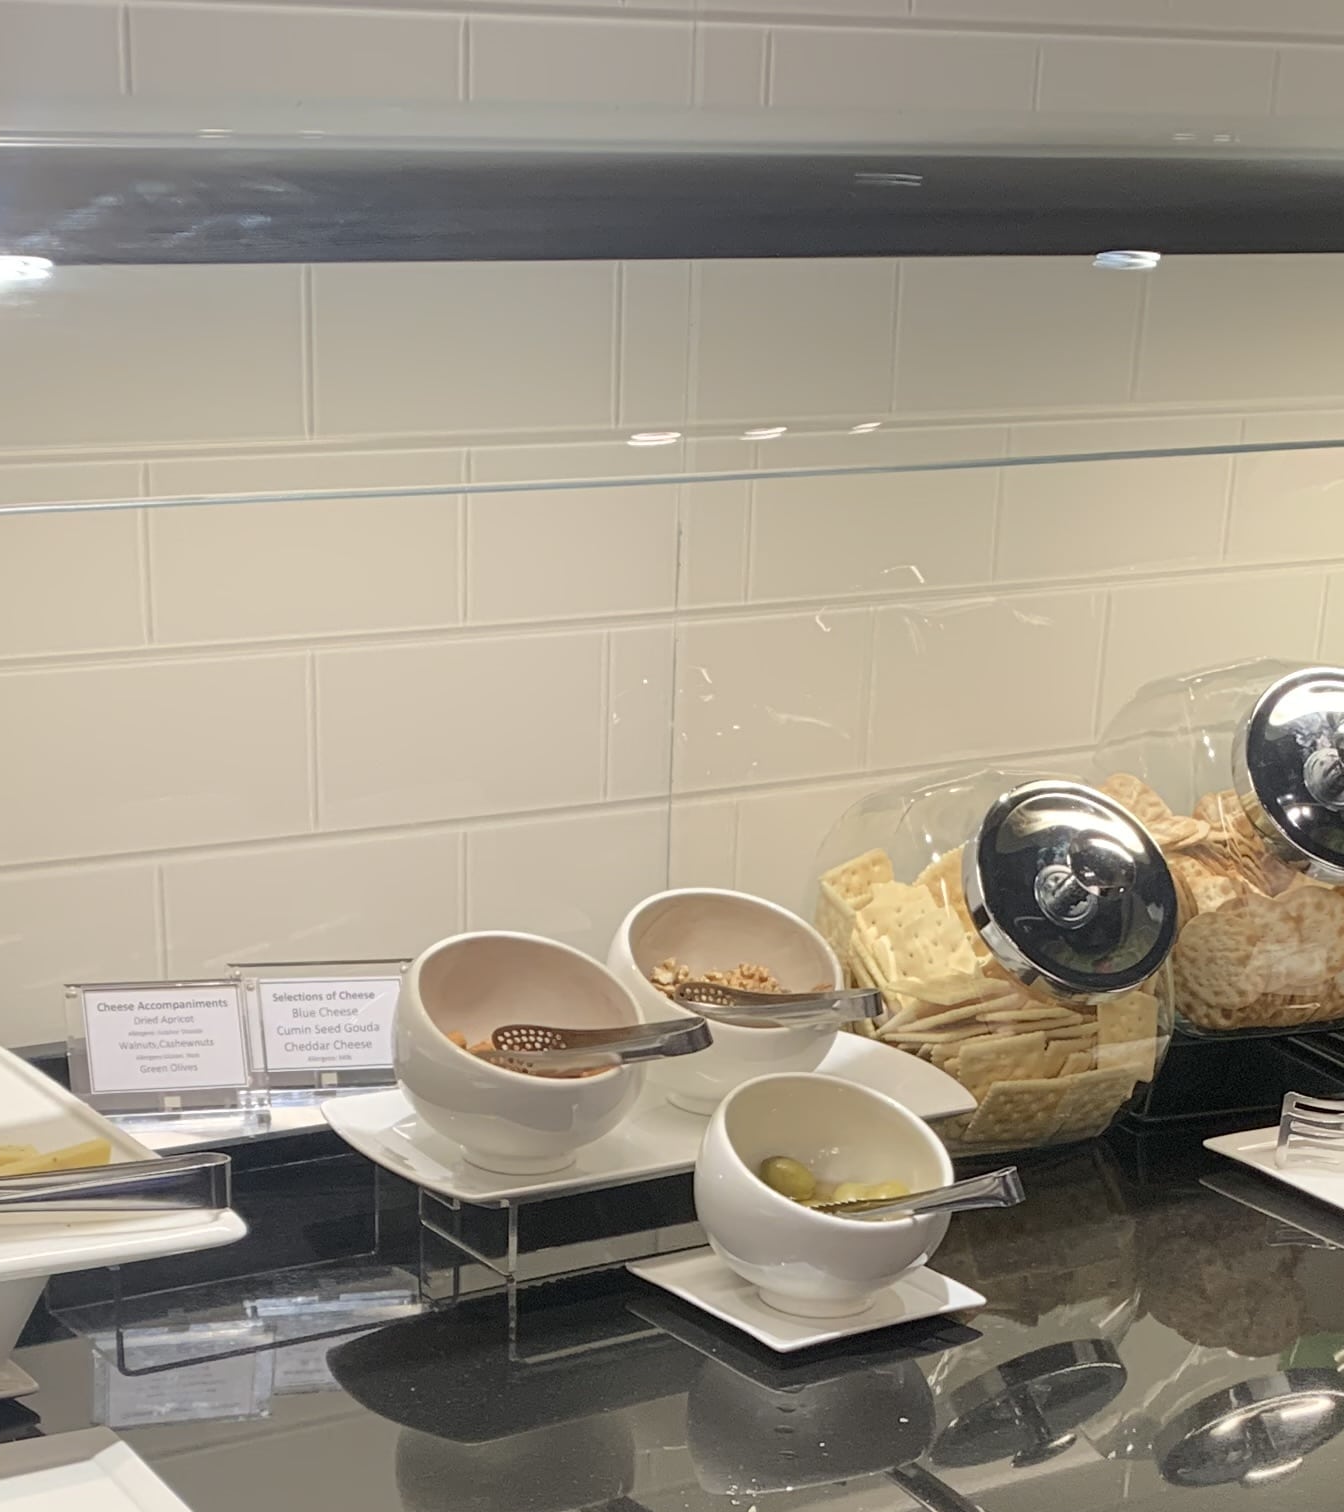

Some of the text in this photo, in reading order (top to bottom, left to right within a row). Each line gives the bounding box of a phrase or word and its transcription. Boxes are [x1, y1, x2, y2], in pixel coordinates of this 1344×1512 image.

[272, 991, 375, 1003] Selections of Cheese
[96, 998, 228, 1012] Cheese Accompaniments
[292, 1007, 359, 1018] Blue Cheese
[133, 1014, 195, 1025] Dried Apricot
[276, 1021, 380, 1036] Cumin Seed Gouda
[283, 1040, 373, 1053] Cheddar Cheese
[139, 1063, 198, 1074] Green Olives
